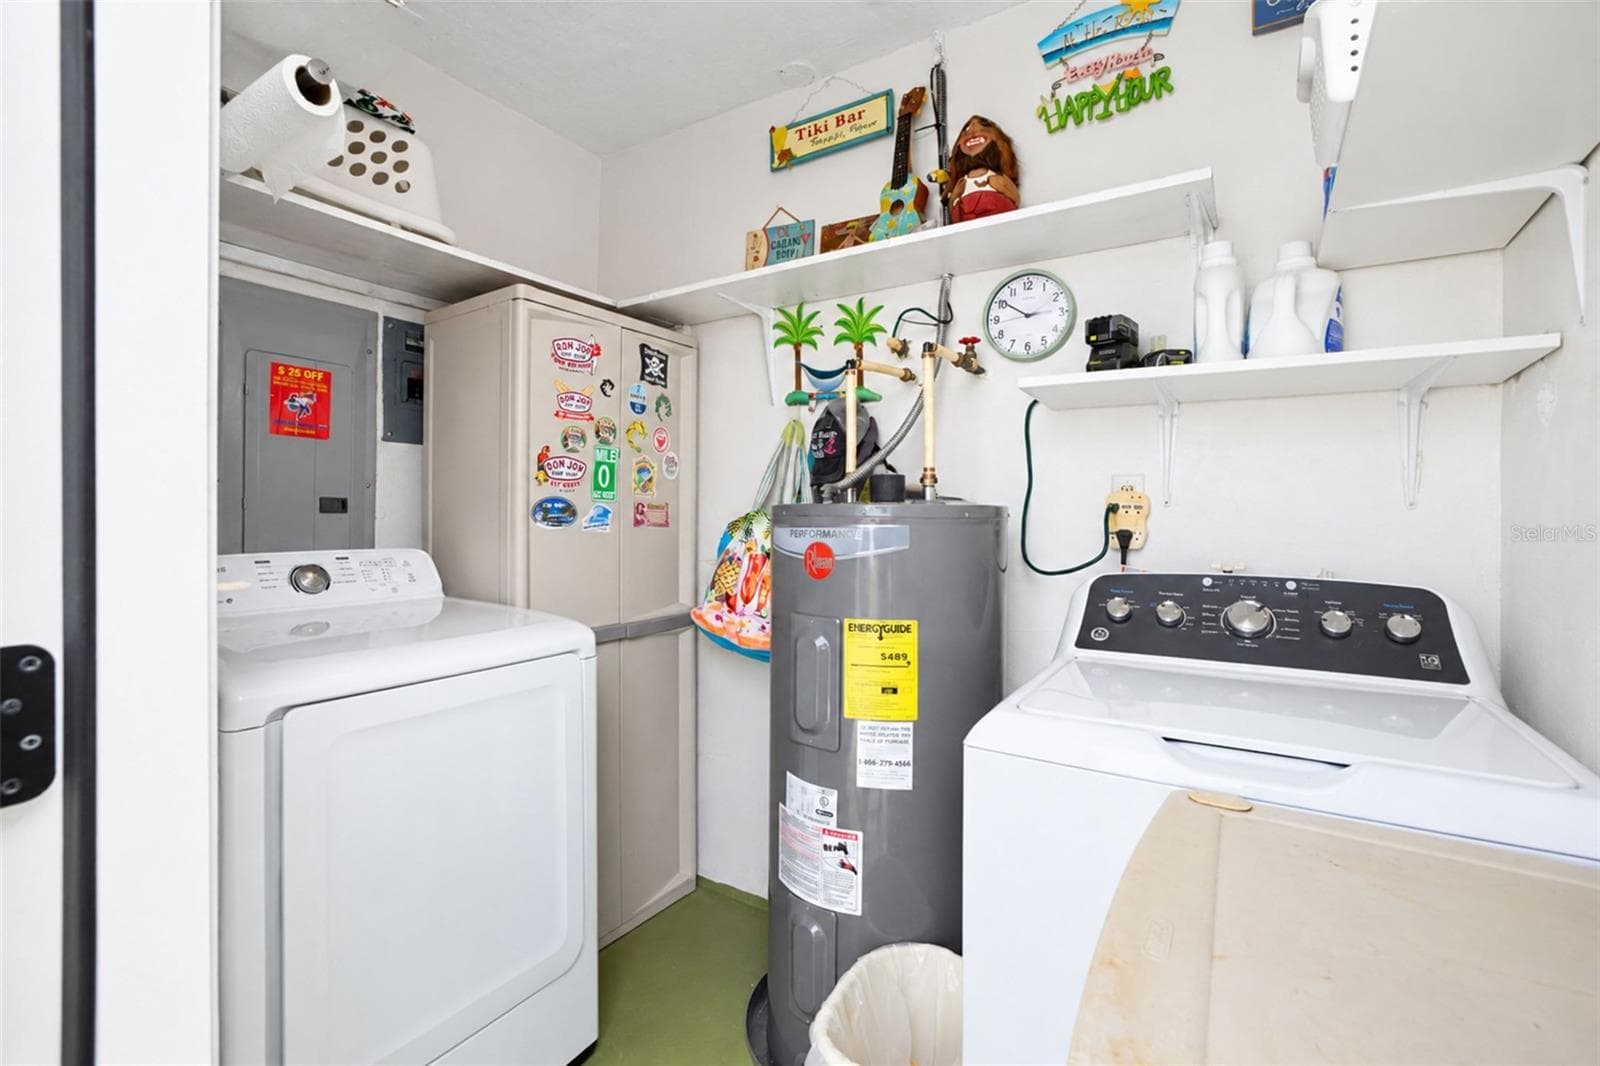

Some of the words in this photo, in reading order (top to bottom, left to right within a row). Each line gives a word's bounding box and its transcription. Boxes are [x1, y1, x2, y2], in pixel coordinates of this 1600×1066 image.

[1039, 72, 1124, 134] HAPPY
[1115, 66, 1174, 112] HOUR
[795, 120, 829, 141] Tiki
[835, 109, 866, 128] Bar
[1023, 280, 1033, 291] 12
[1042, 282, 1046, 292] 1
[1009, 288, 1017, 297] 11
[1052, 292, 1059, 302] 2
[998, 299, 1008, 310] 10
[1058, 306, 1065, 317] 3
[993, 315, 1000, 325] 9
[1052, 323, 1058, 333] 4
[998, 329, 1004, 340] 8
[1010, 339, 1016, 350] 7
[1041, 335, 1047, 346] 5
[1024, 341, 1031, 352] 6
[288, 367, 301, 378] 25
[304, 370, 324, 381] OFF
[596, 449, 617, 462] MILE
